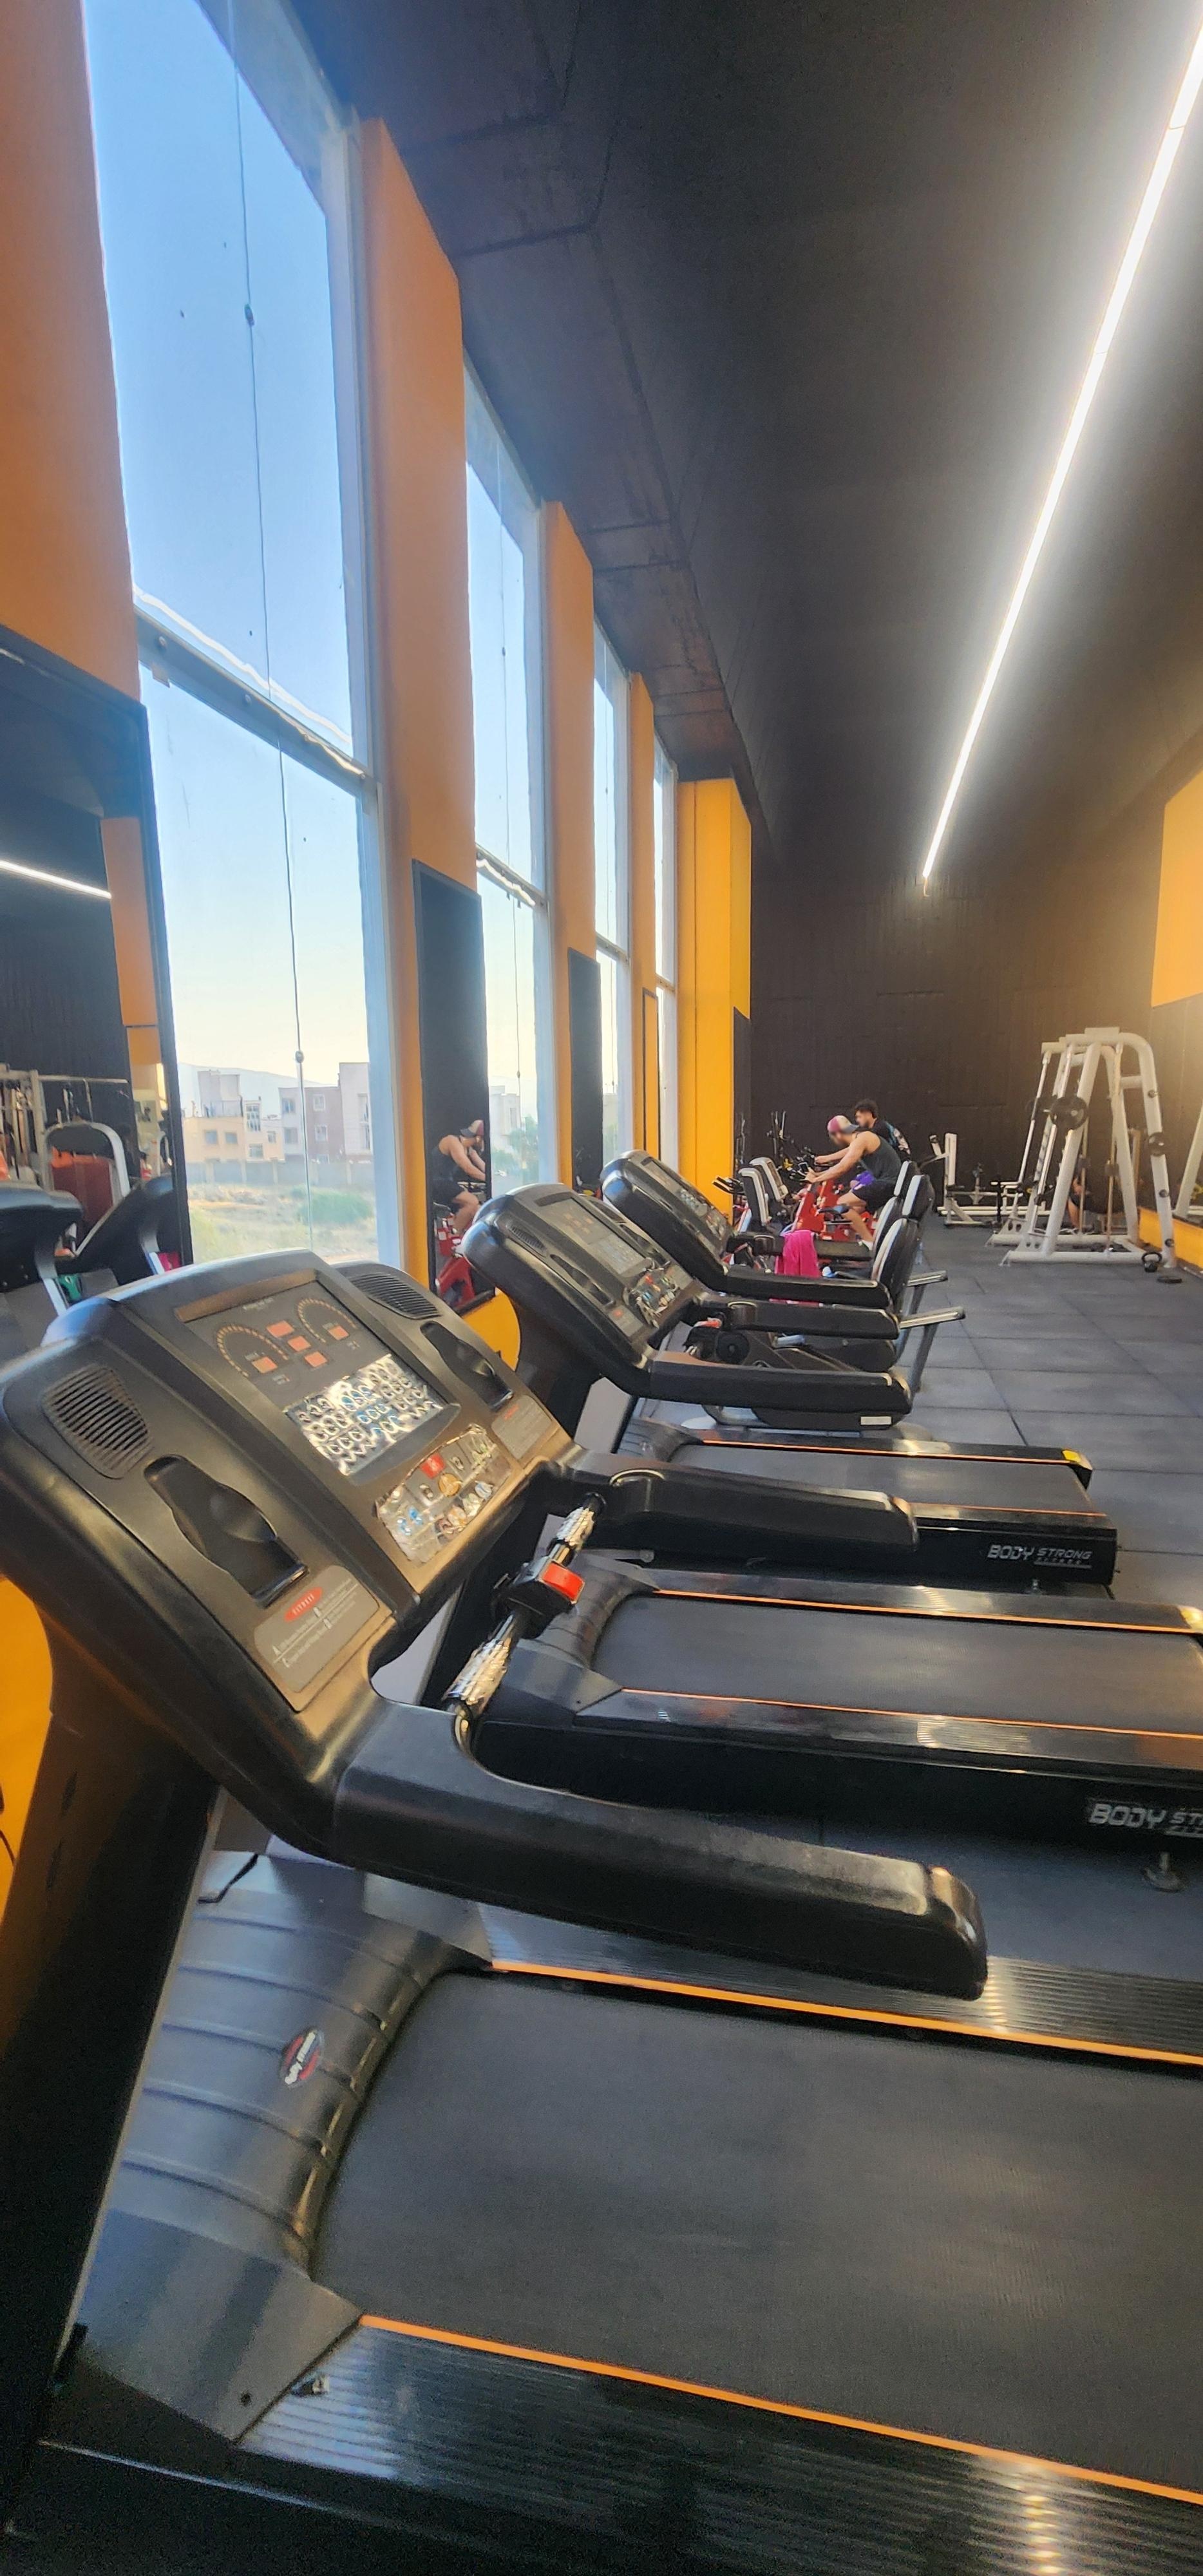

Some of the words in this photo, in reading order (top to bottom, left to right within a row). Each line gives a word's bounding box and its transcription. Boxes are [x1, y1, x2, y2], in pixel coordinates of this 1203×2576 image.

[987, 1544, 1035, 1560] BODY
[1037, 1548, 1093, 1560] STRONG
[1089, 1803, 1166, 1830] BODY
[1169, 1811, 1203, 1825] ST
